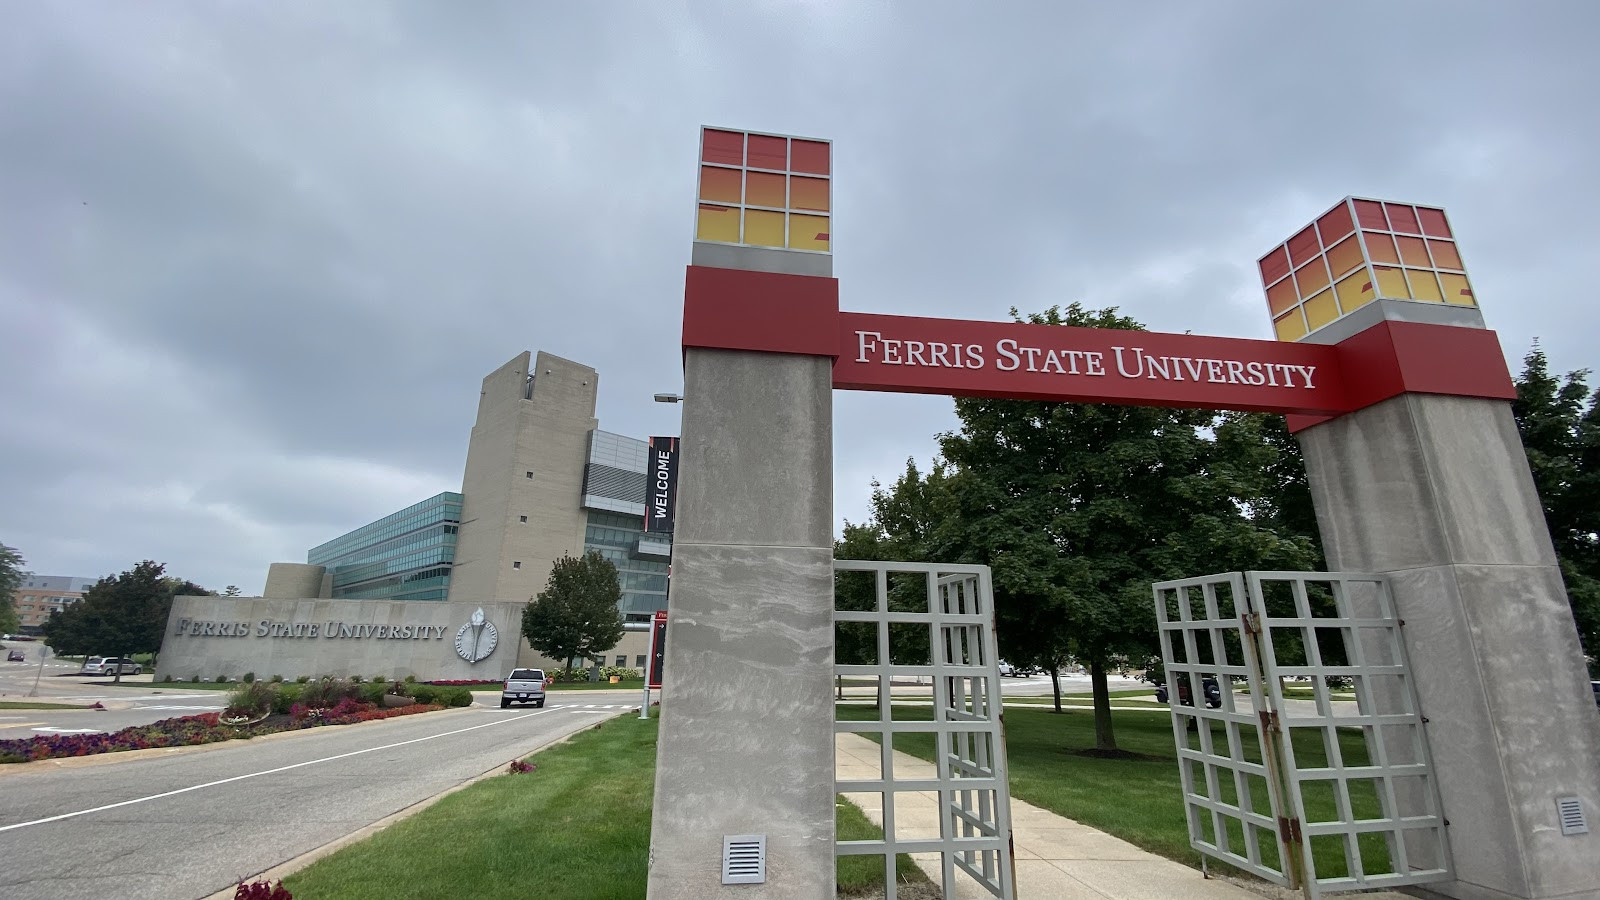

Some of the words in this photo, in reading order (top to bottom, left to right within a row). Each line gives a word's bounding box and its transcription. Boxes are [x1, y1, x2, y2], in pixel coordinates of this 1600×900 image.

[854, 330, 985, 369] FERRIS
[996, 338, 1106, 376] STATE
[1110, 346, 1316, 389] UNIVERSITY
[655, 450, 670, 518] WELCOME
[175, 617, 250, 638] FERRIS
[256, 619, 319, 639] STATE
[323, 620, 447, 640] UNIVERSITY
